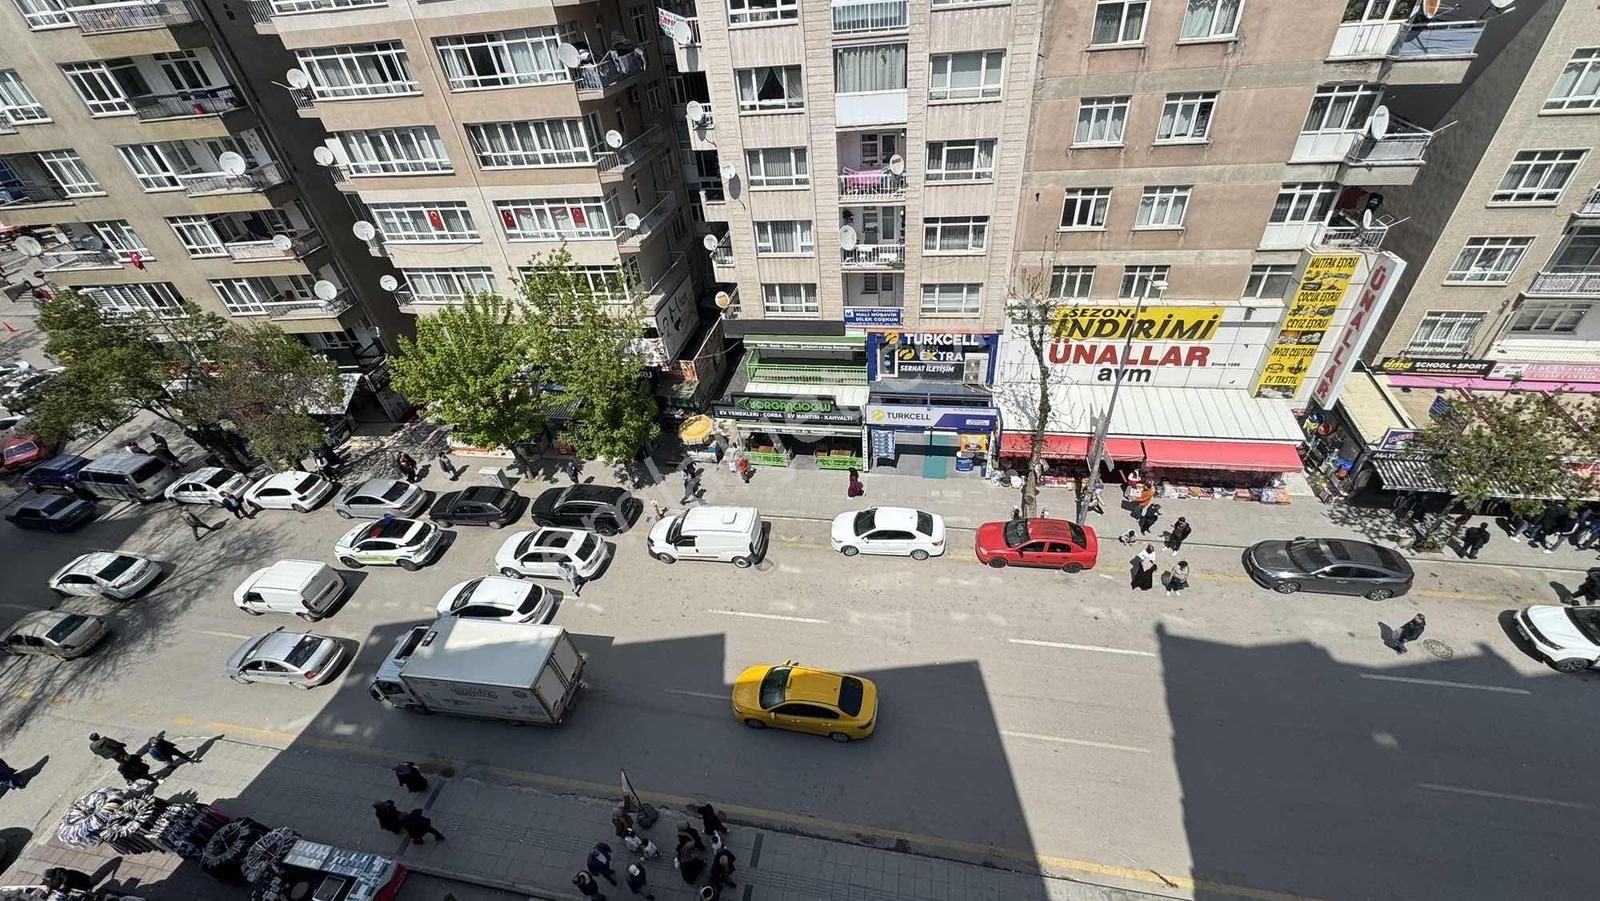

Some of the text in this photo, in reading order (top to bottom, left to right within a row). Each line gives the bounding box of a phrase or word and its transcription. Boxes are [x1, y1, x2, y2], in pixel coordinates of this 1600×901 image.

[1069, 308, 1132, 319] SEZON
[1053, 313, 1219, 340] İNDİRİMİ
[1316, 265, 1386, 399] ÜNALLAR
[904, 332, 979, 346] TURKCELL
[919, 351, 964, 361] EXTRA
[1049, 338, 1210, 366] ÜNALLAR
[900, 364, 955, 374] SERHAT İLETİŞİM
[1415, 361, 1450, 369] SCHOOL
[887, 412, 932, 421] TURKCELL
